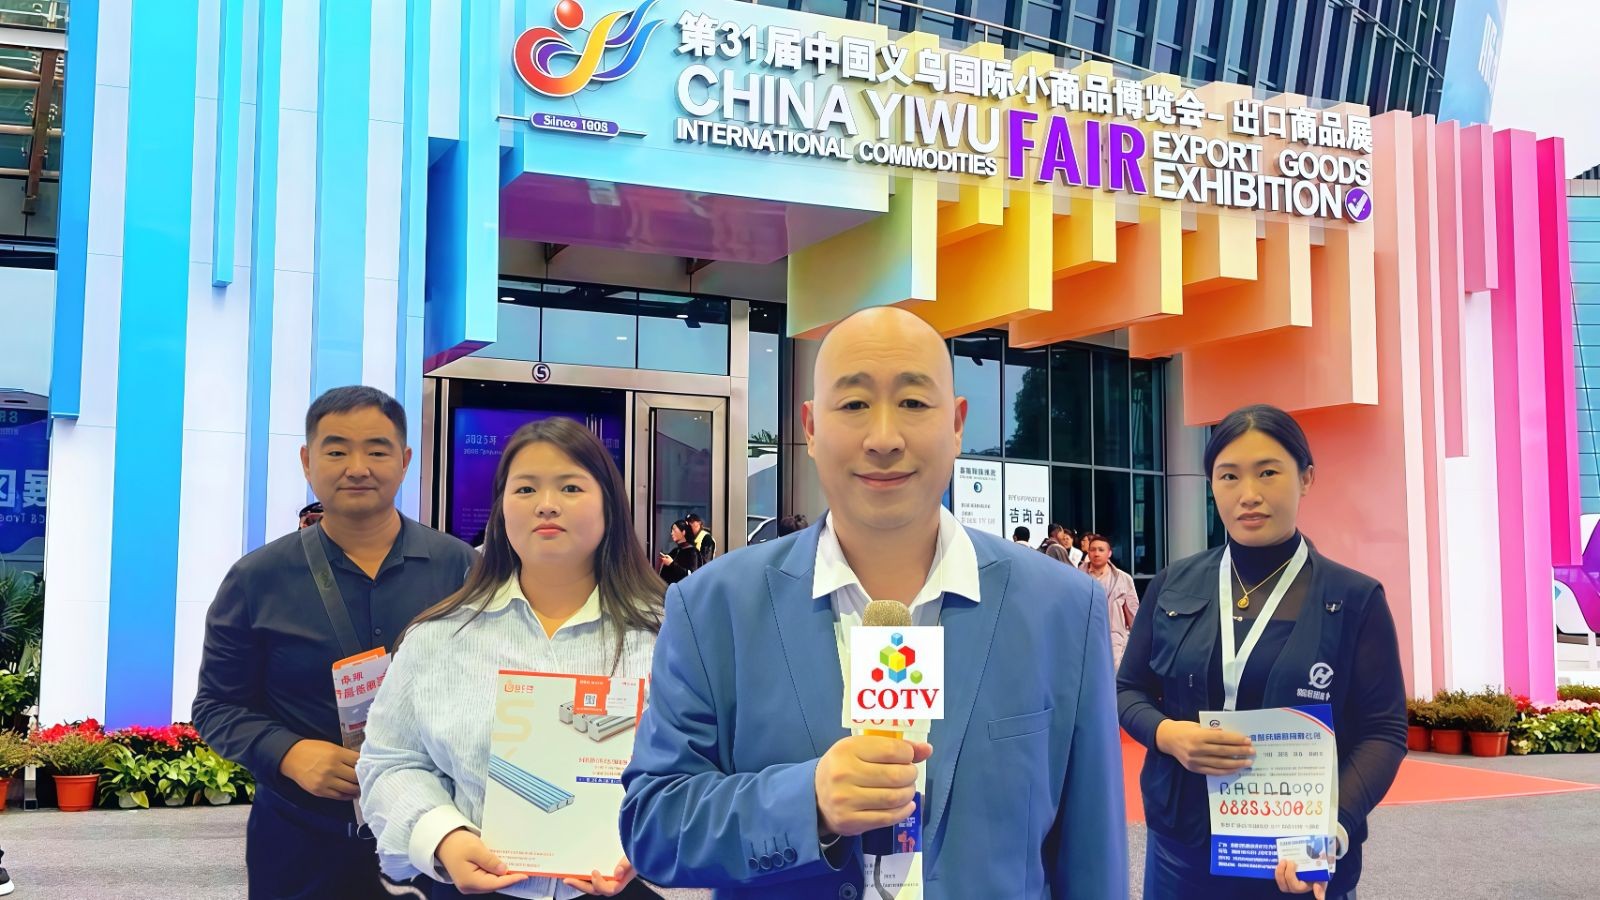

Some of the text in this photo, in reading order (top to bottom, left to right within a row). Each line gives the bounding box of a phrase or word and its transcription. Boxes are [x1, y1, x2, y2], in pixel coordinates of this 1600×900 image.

[677, 117, 998, 177] INTERNATIONAL COMMODITIES
[678, 63, 1148, 195] CHINA YIWU FAIR
[1153, 131, 1372, 187] EXPORT GOODS
[1154, 160, 1344, 219] EXHIBITION
[856, 688, 940, 710] COTV
